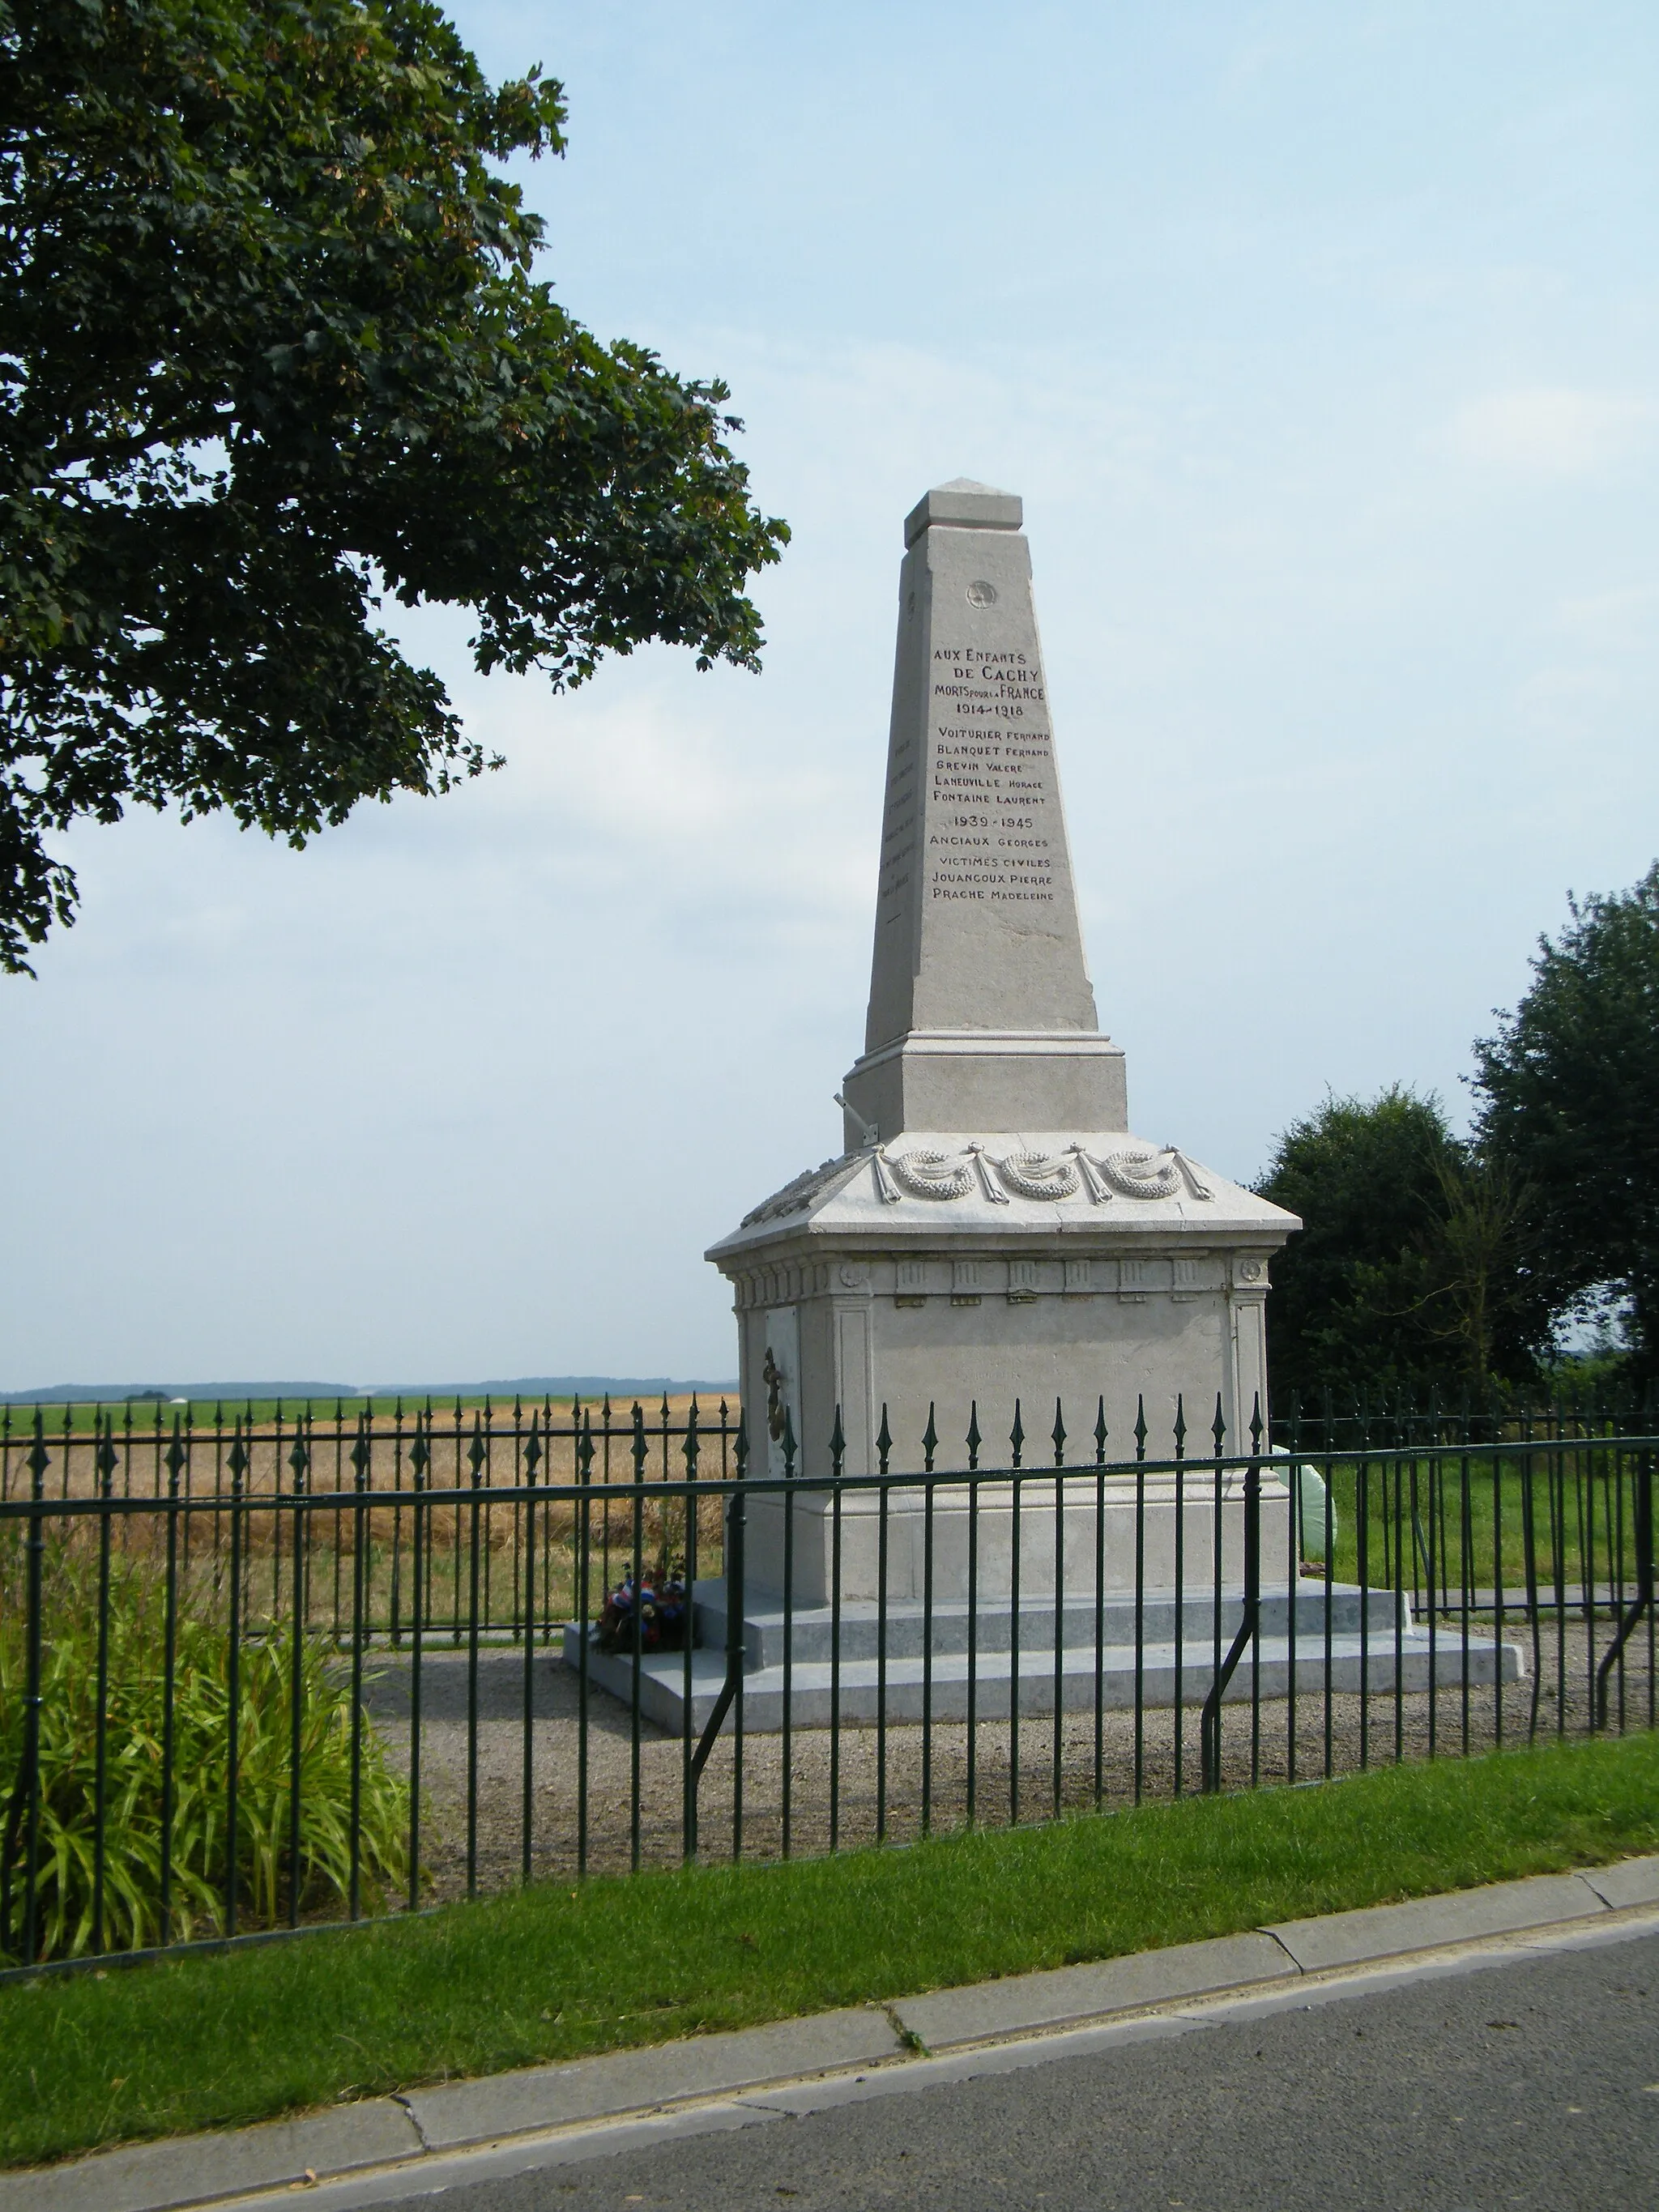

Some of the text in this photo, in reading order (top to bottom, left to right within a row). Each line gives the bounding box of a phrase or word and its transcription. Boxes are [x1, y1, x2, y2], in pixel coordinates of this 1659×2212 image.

[934, 649, 1026, 664] AUX ENFANTS
[953, 667, 1038, 682] DE CACHY
[935, 684, 970, 697] MORTS
[1000, 684, 1043, 700] FRANCE
[957, 703, 1023, 716] 1914-1918
[939, 727, 1050, 742] VOITURIER FERNAND
[937, 744, 1048, 758] BLANQUET FERNAND
[936, 761, 1022, 774] GREVIN VALERE
[935, 775, 1043, 789] LANEUVILLE HORACE
[933, 791, 1045, 806] FONTAINE LAURENT
[930, 835, 1048, 848] ANCIAUX GEORGES
[940, 857, 1050, 867] VICTIMES CIVILES
[932, 872, 1051, 886] JOUANCOUX PIERRE
[933, 888, 1053, 901] PRACHE MADELEINE
